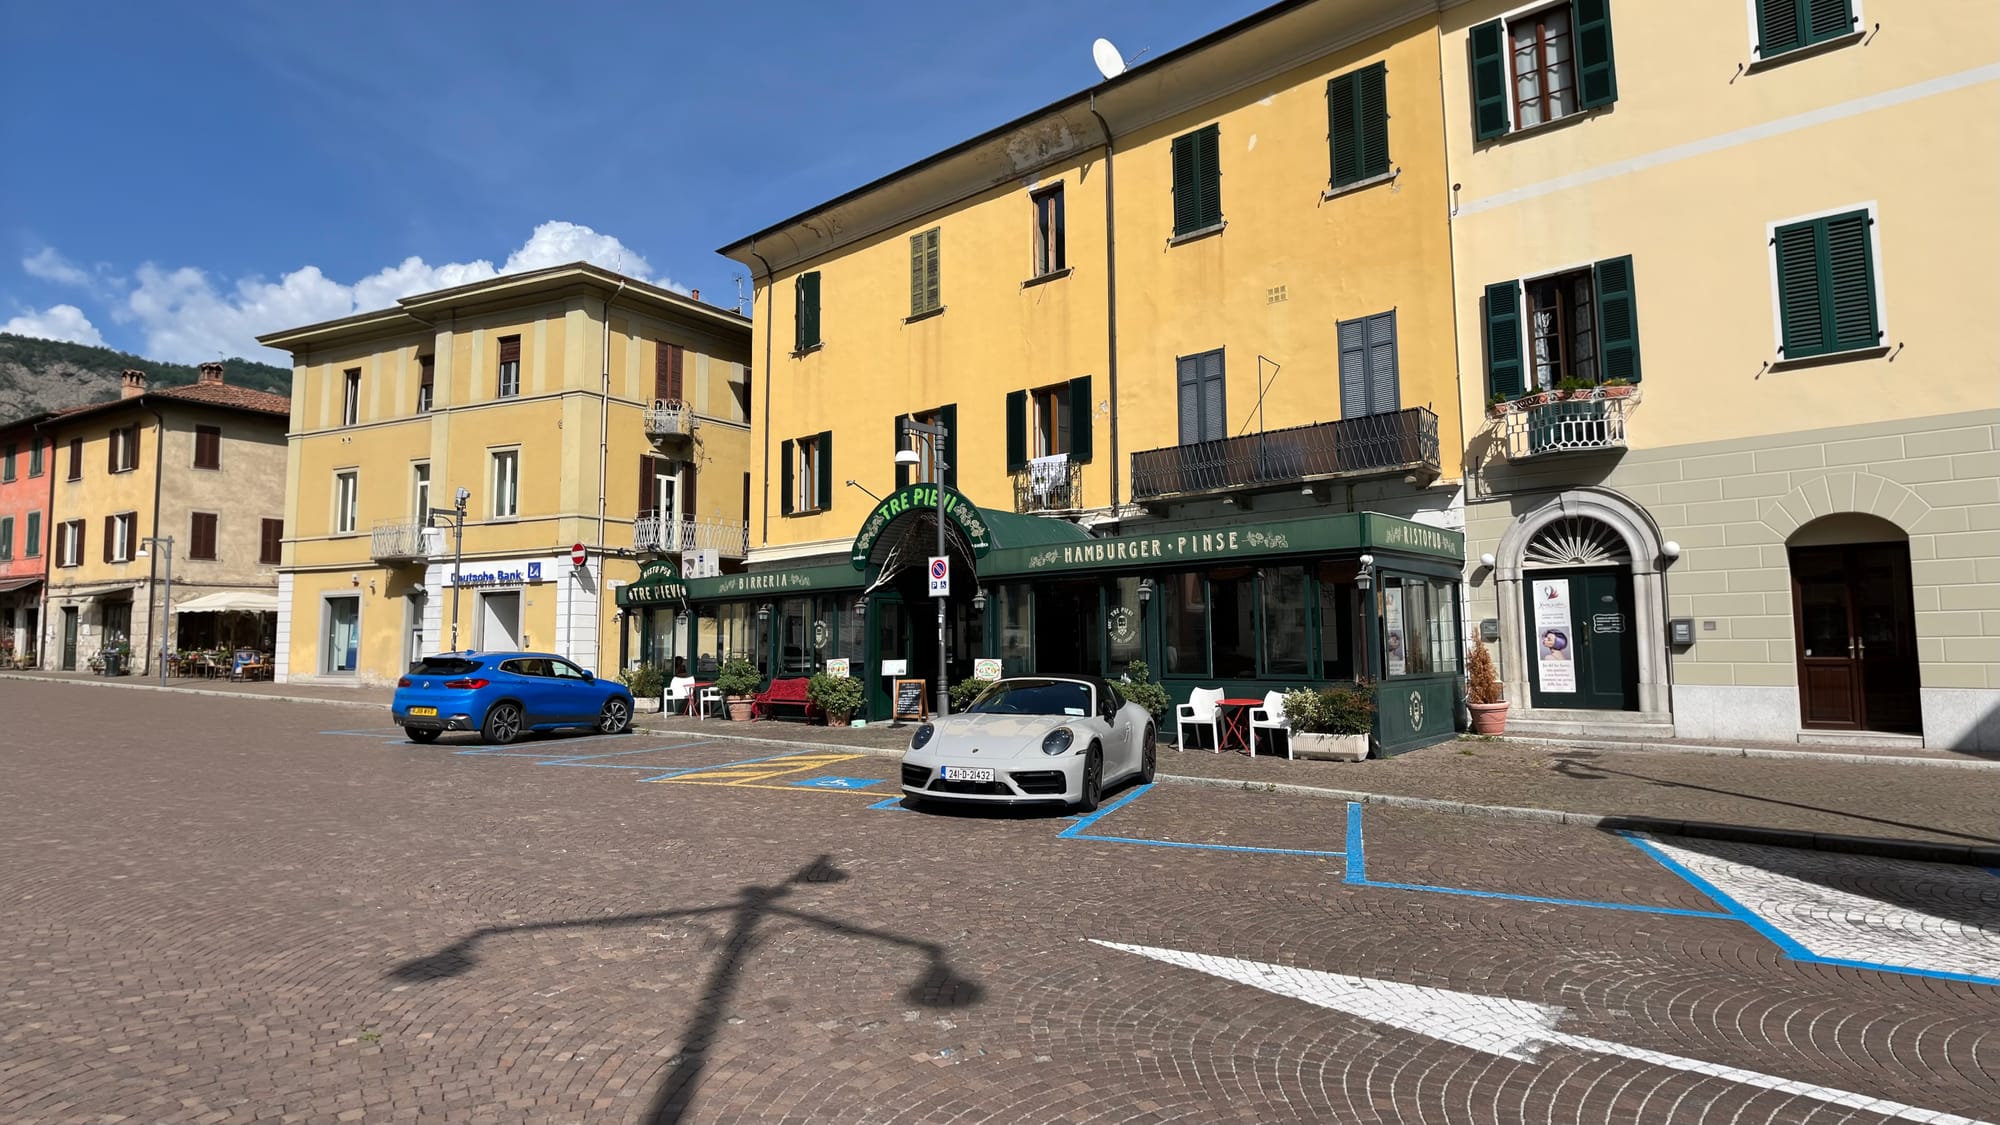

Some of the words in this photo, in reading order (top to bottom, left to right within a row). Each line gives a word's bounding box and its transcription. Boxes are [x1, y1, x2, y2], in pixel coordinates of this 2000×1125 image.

[879, 492, 910, 520] TRE
[1403, 526, 1441, 550] RISTOPUB
[1064, 539, 1162, 564] HAMBURGER
[1178, 531, 1238, 555] PINSE
[497, 569, 521, 581] Bank
[739, 574, 787, 590] BIRRERIA
[632, 586, 651, 601] TRE
[654, 584, 681, 599] PIEVI
[949, 769, 990, 780] 241-D-21432
